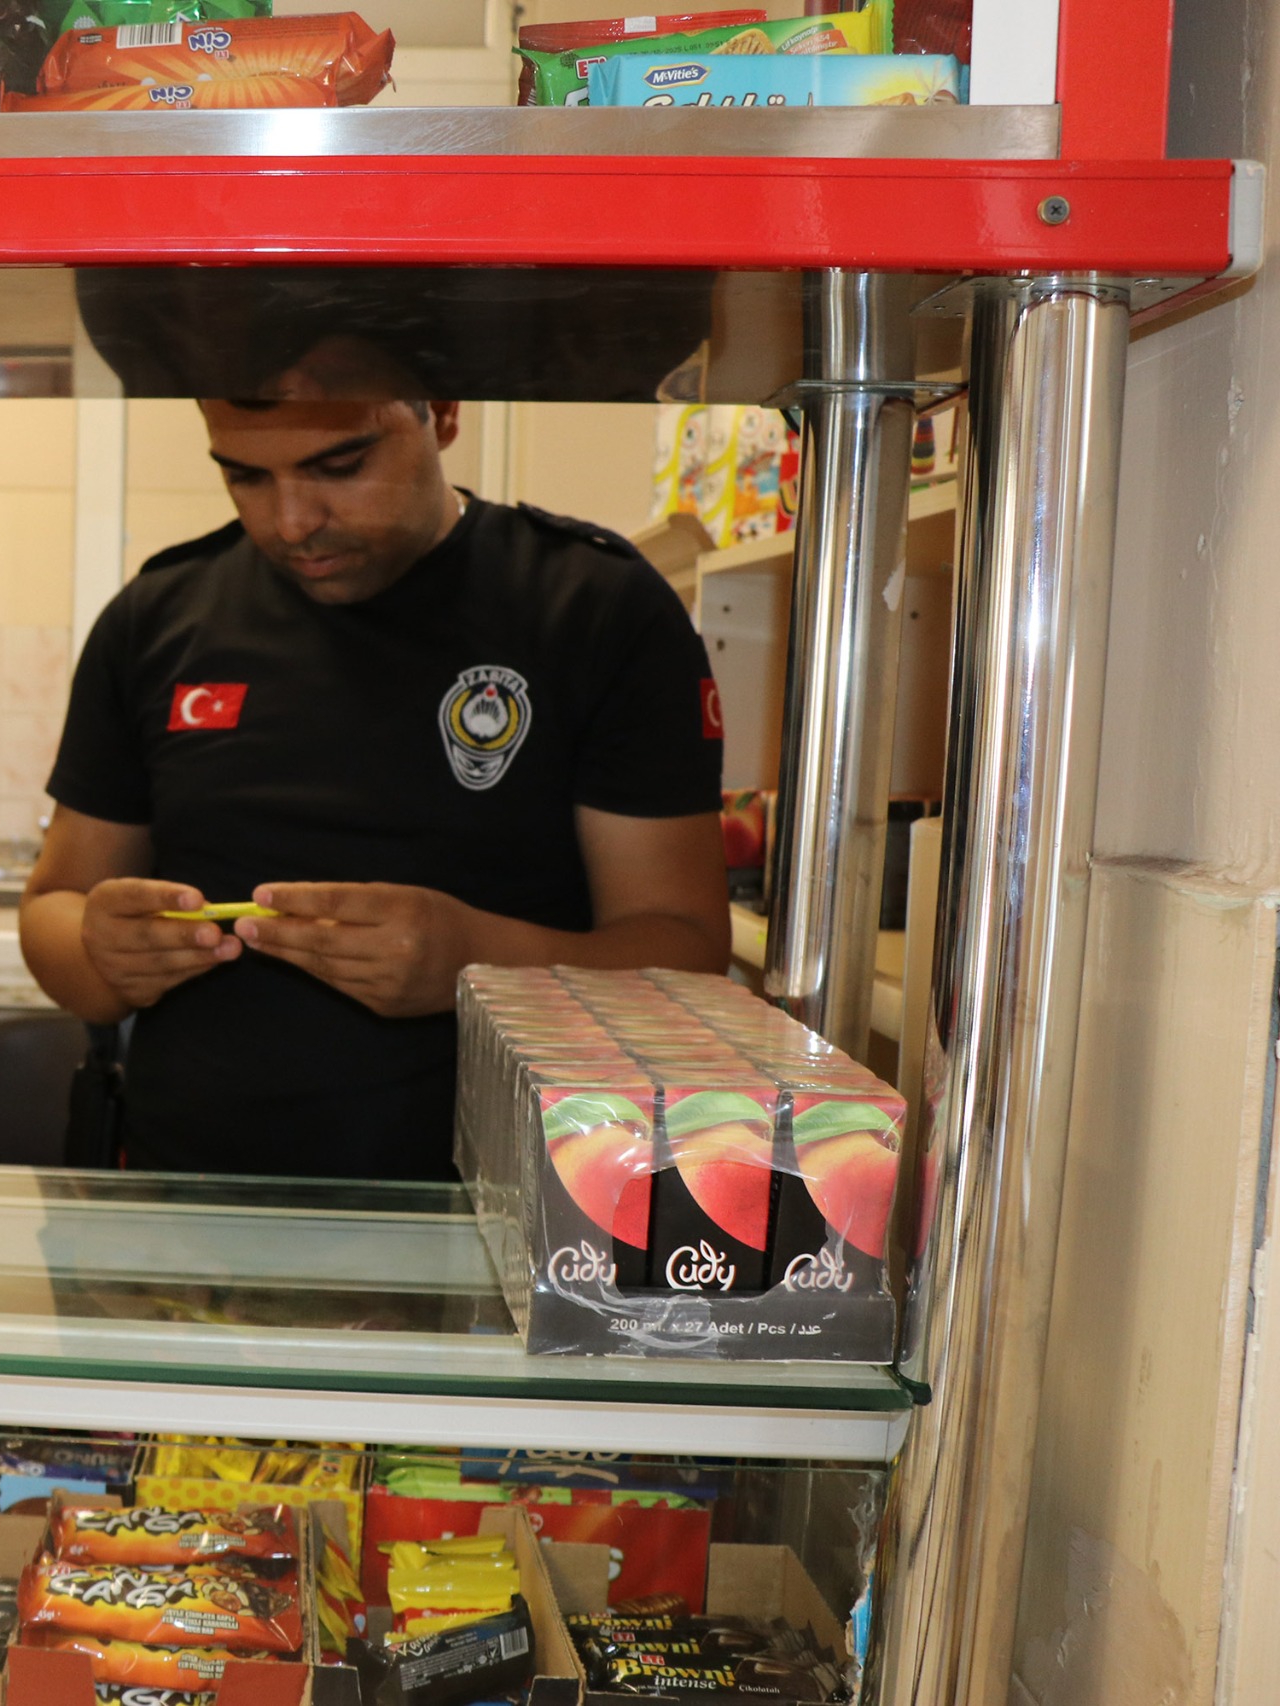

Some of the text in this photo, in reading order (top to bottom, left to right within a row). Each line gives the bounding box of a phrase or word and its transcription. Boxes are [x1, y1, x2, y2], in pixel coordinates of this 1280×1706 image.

[610, 1317, 638, 1331] 200
[684, 1322, 703, 1333] 27
[707, 1321, 745, 1335] Adet
[757, 1322, 786, 1335] Pcs
[611, 1657, 736, 1687] Browni
[653, 1675, 717, 1690] intense
